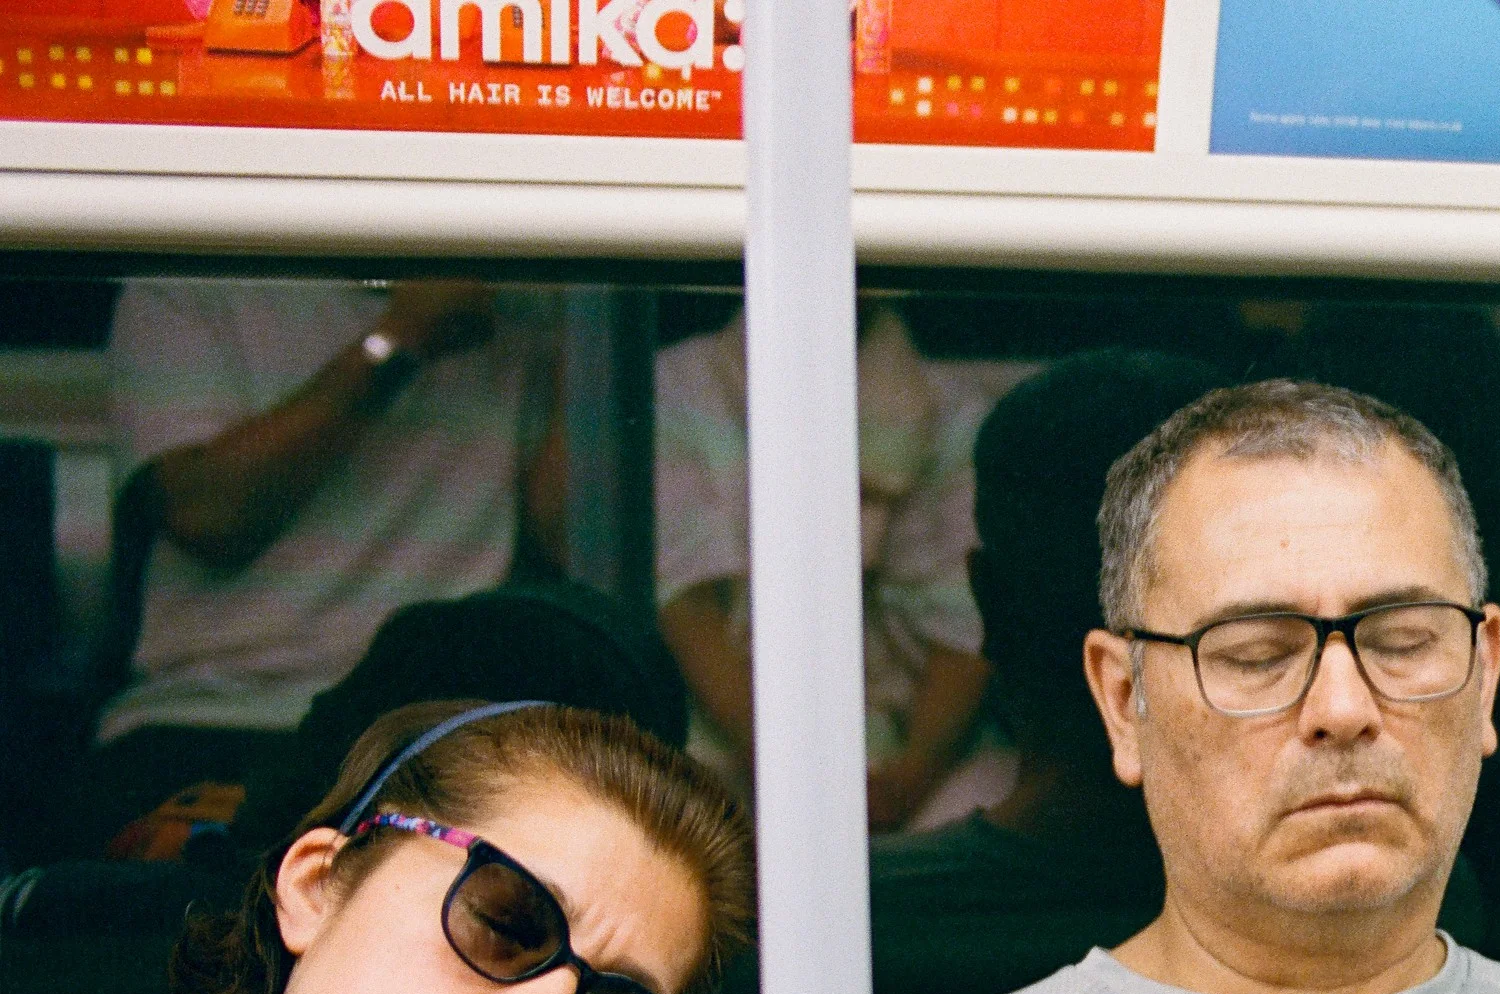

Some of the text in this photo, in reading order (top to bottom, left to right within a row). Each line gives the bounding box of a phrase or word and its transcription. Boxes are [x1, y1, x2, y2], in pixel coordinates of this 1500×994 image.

[379, 79, 432, 103] ALL
[448, 81, 521, 106] HAIR
[536, 84, 572, 107] IS
